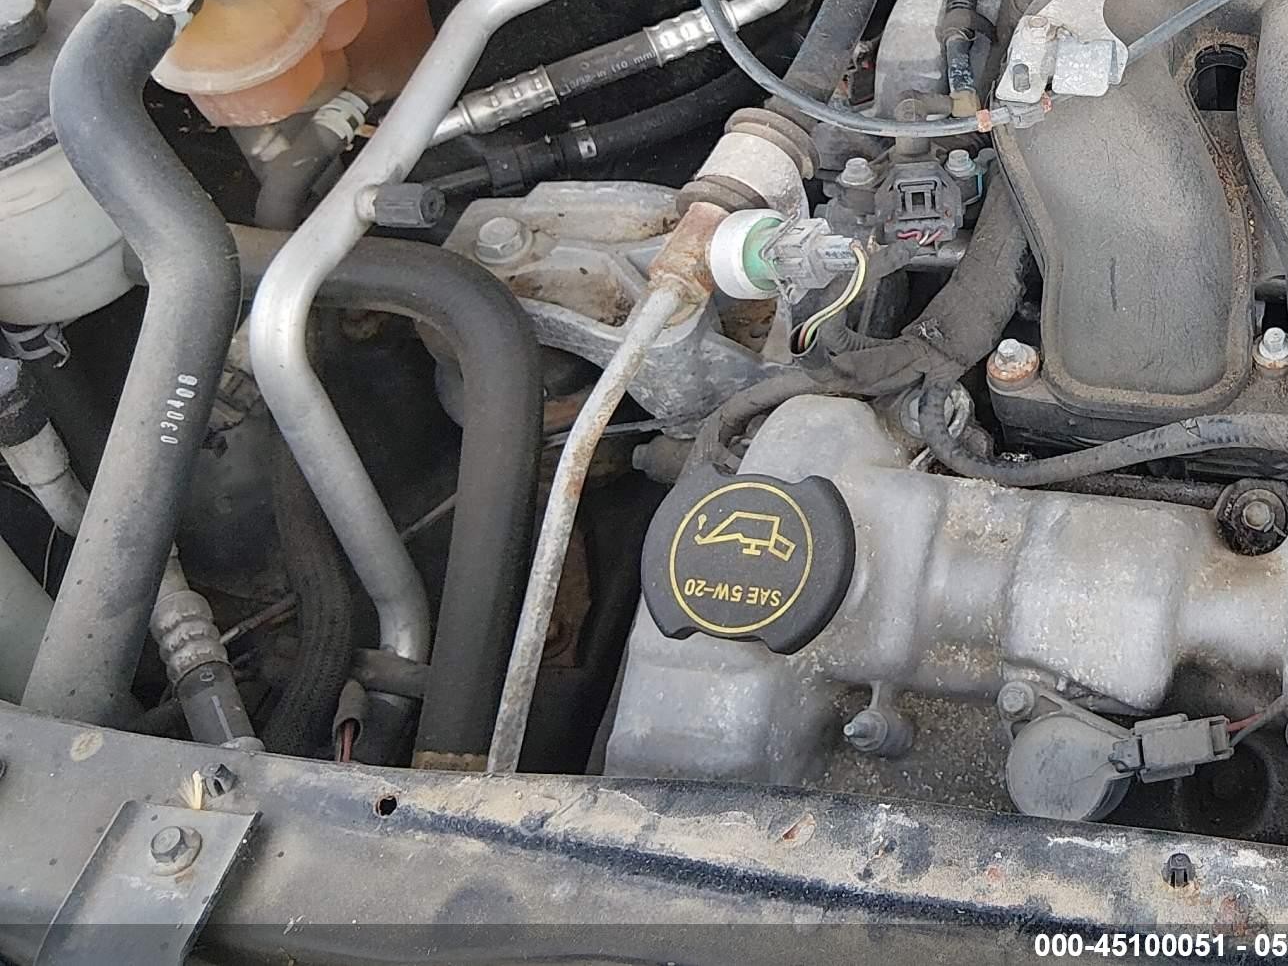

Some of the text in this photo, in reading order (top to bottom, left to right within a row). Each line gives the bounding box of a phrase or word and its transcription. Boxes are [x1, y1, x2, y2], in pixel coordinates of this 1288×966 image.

[160, 373, 198, 445] 030408
[684, 578, 783, 608] SAE 5W-20
